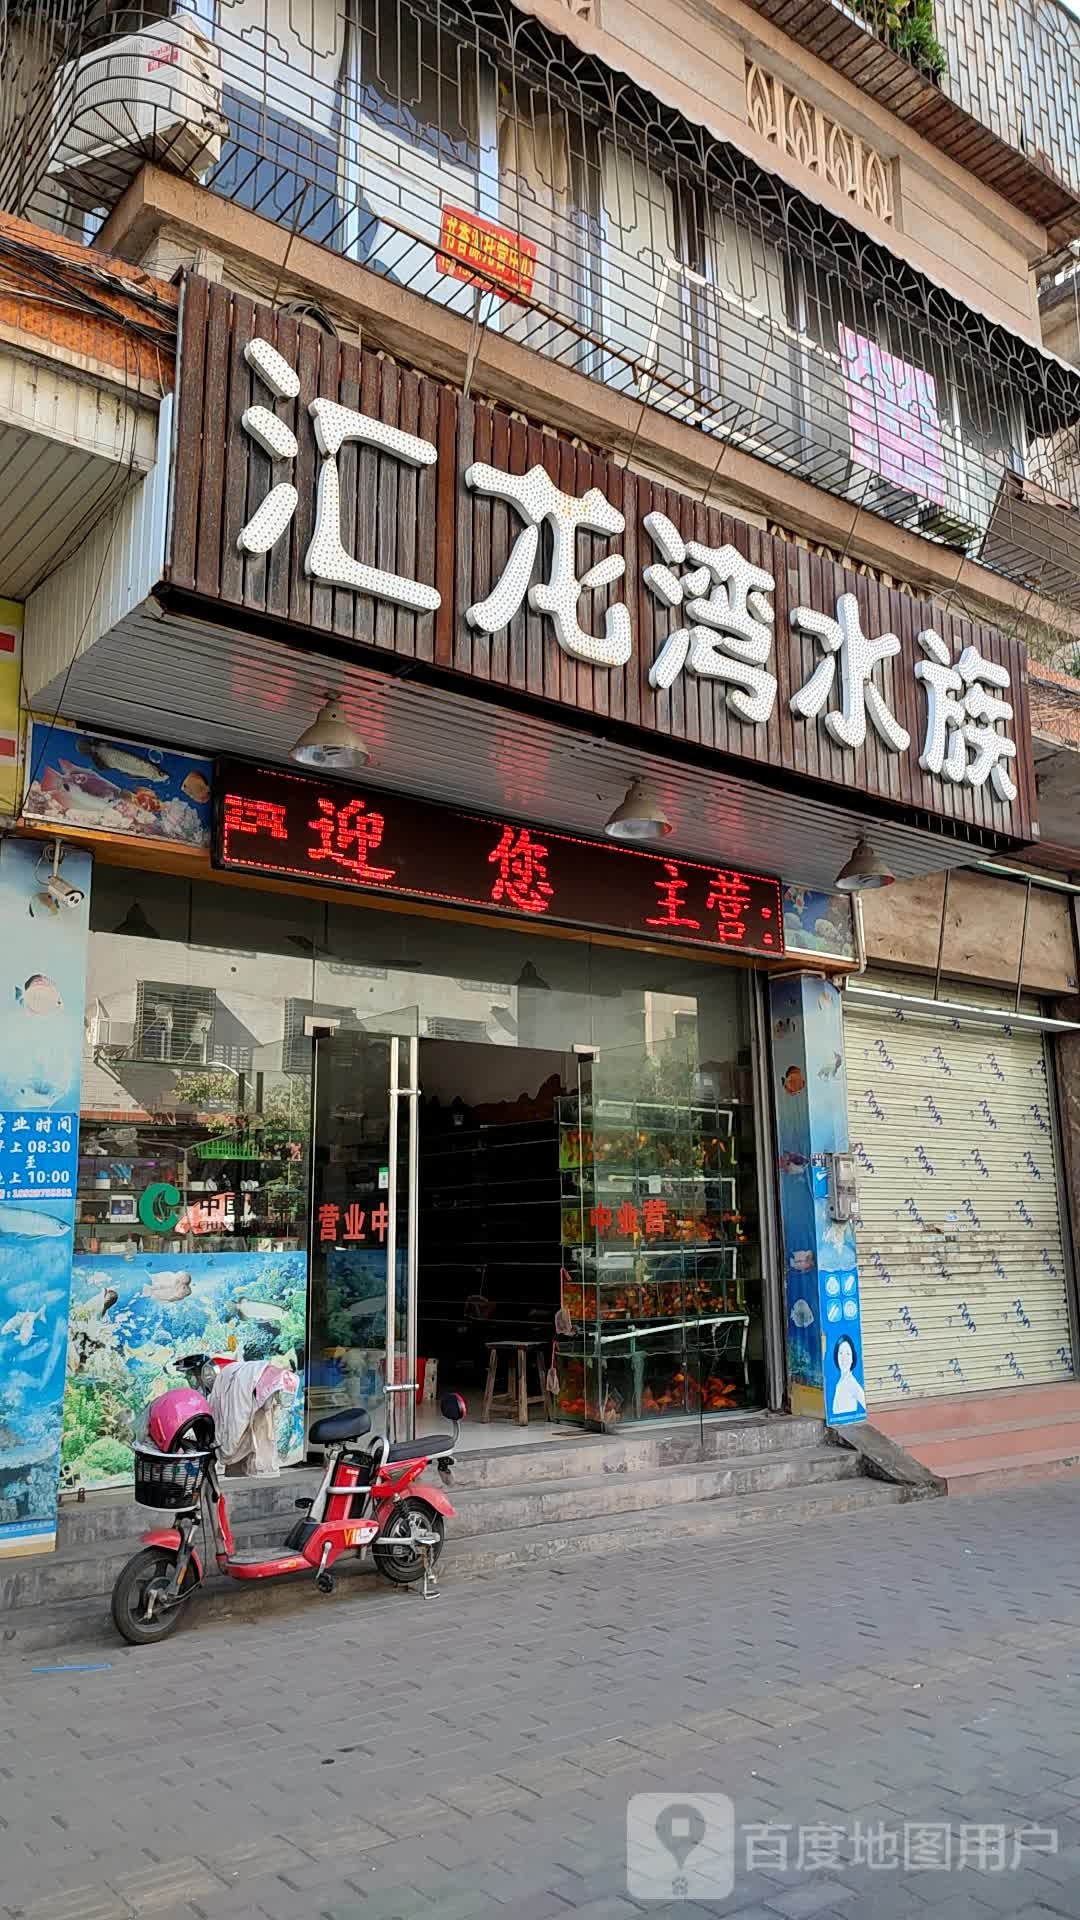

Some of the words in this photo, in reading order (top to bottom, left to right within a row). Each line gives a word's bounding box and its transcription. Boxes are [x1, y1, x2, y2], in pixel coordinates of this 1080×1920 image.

[236, 337, 1017, 801] 汇龙湾水族
[488, 825, 555, 914] 您
[0, 1169, 70, 1185] 上10:00
[25, 1154, 37, 1169] 至
[319, 1202, 389, 1243] 营业中
